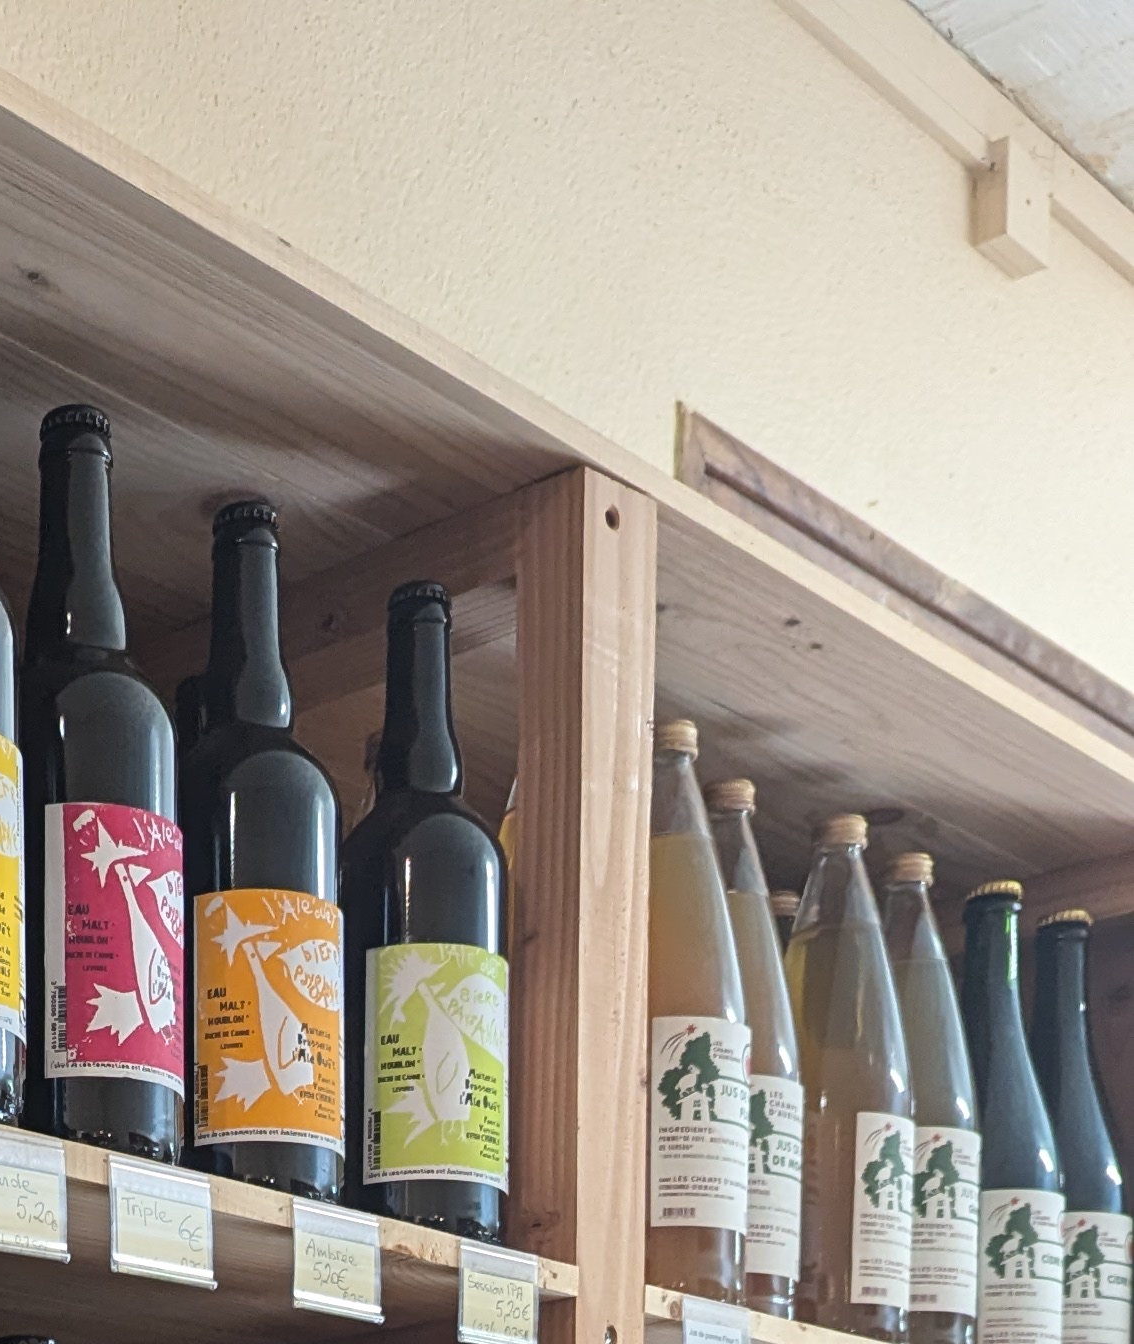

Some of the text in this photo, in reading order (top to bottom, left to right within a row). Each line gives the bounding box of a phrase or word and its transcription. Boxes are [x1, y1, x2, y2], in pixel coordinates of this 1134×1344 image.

[720, 1084, 738, 1098] JUS
[16, 1196, 59, 1232] 5,20€
[122, 1197, 204, 1252] Triple 6€
[305, 1238, 358, 1266] Ambrée
[313, 1261, 349, 1291] 5,20€
[495, 1300, 531, 1324] 5,20€
